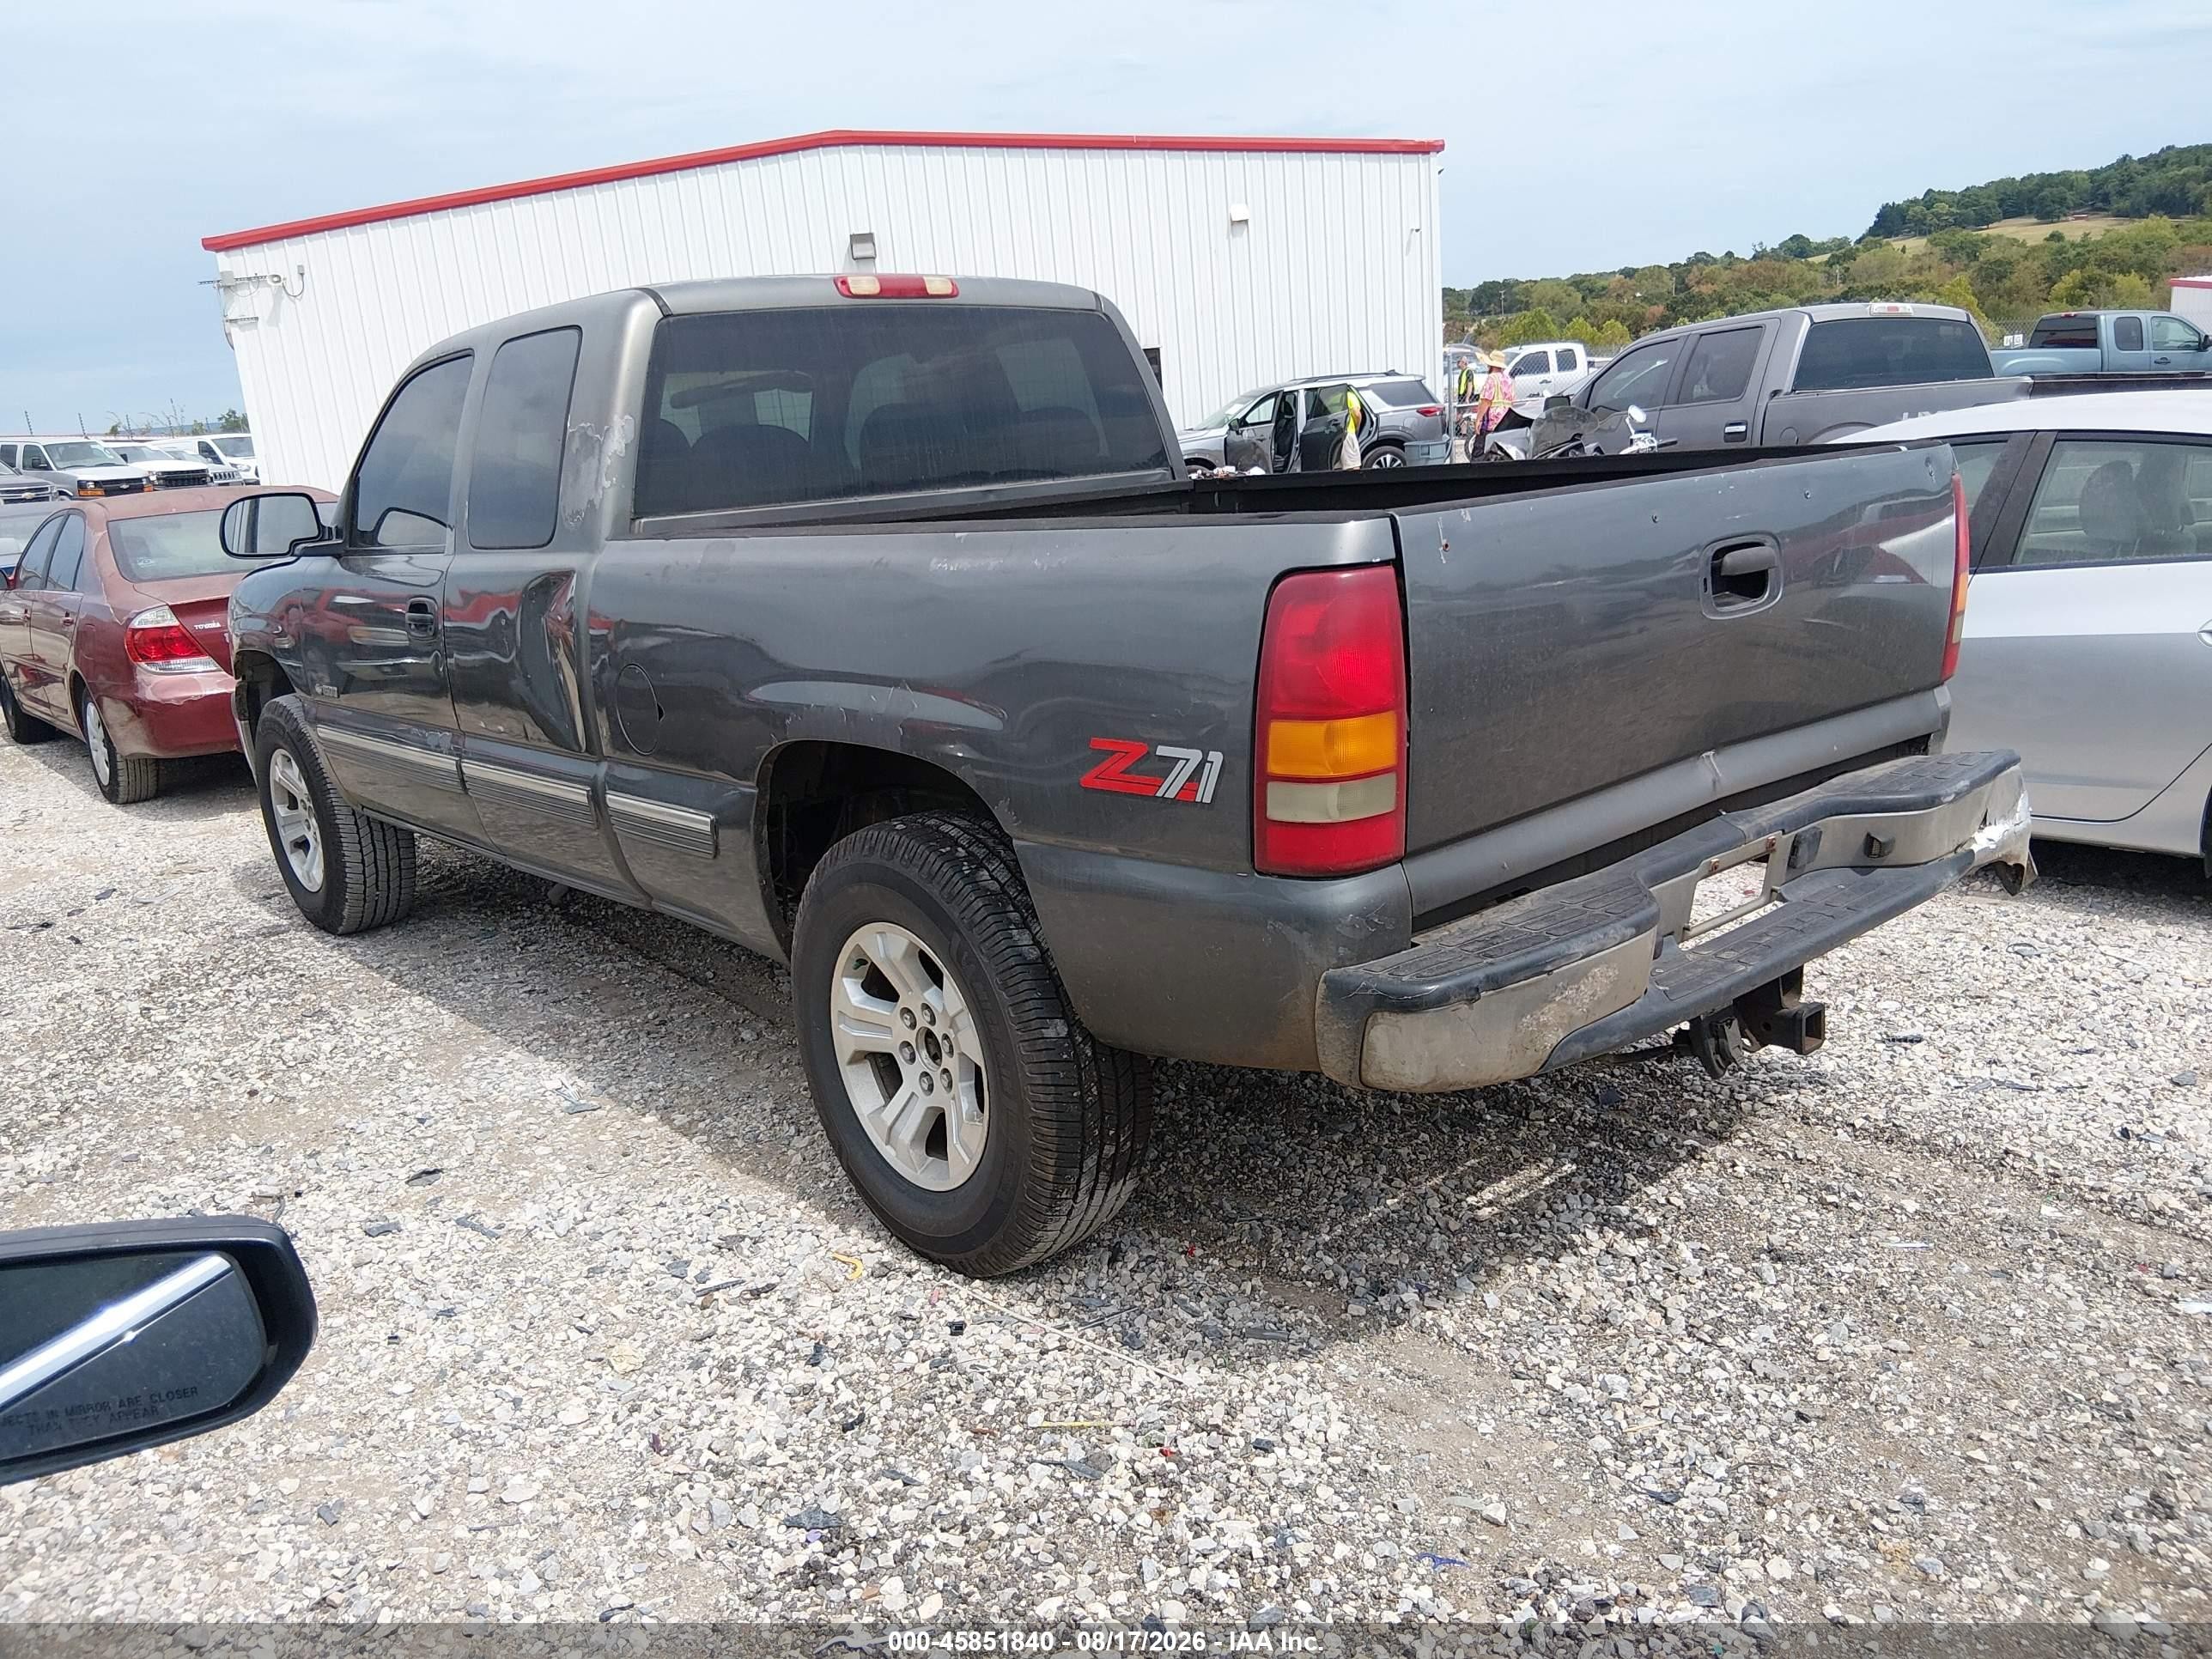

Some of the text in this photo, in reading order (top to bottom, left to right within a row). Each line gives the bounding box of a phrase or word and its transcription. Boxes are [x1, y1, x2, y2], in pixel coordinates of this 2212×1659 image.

[1079, 737, 1224, 804] Z71
[64, 1401, 112, 1417] MIRROR
[118, 1395, 142, 1409] ARE
[149, 1387, 198, 1403] CLOSER
[69, 1413, 100, 1429] TEY
